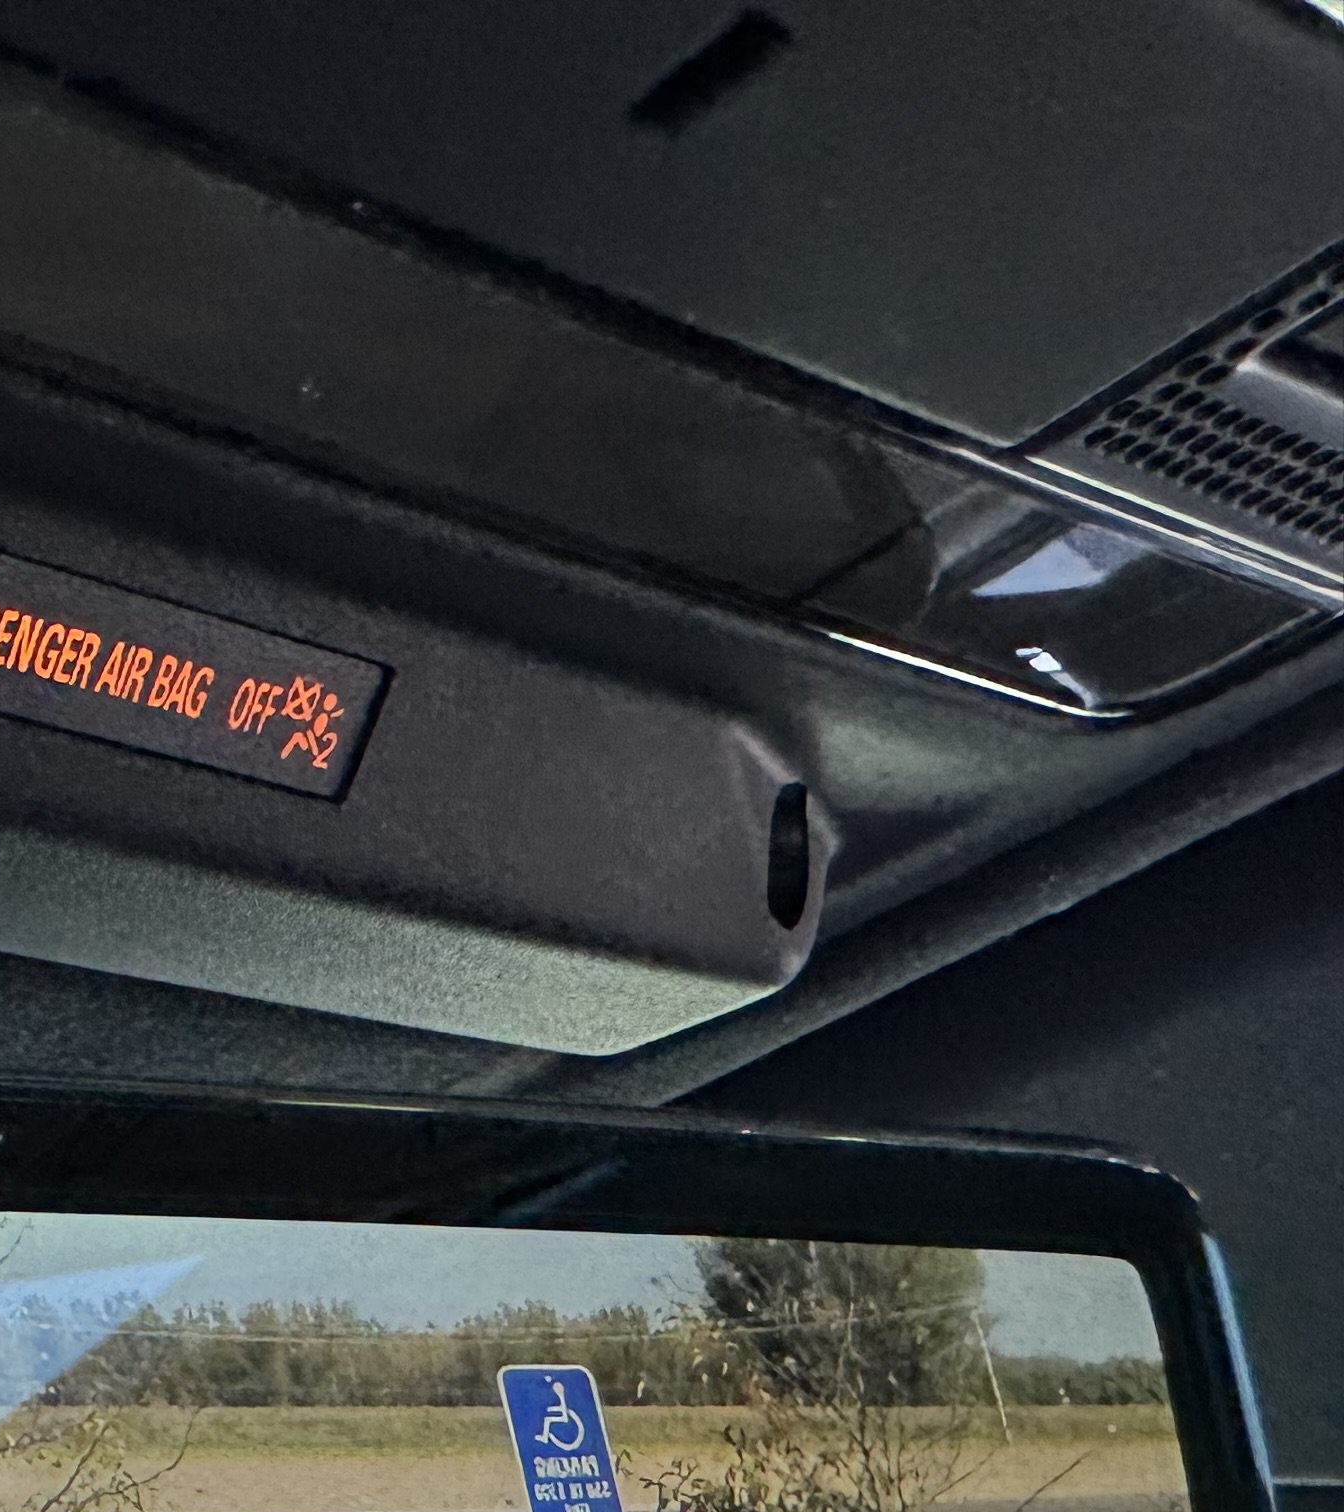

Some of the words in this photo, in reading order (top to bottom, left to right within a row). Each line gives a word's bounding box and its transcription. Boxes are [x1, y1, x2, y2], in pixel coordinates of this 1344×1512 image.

[94, 640, 155, 703] AIR
[147, 654, 216, 719] BAG
[227, 677, 283, 735] OFF
[312, 731, 338, 769] 2
